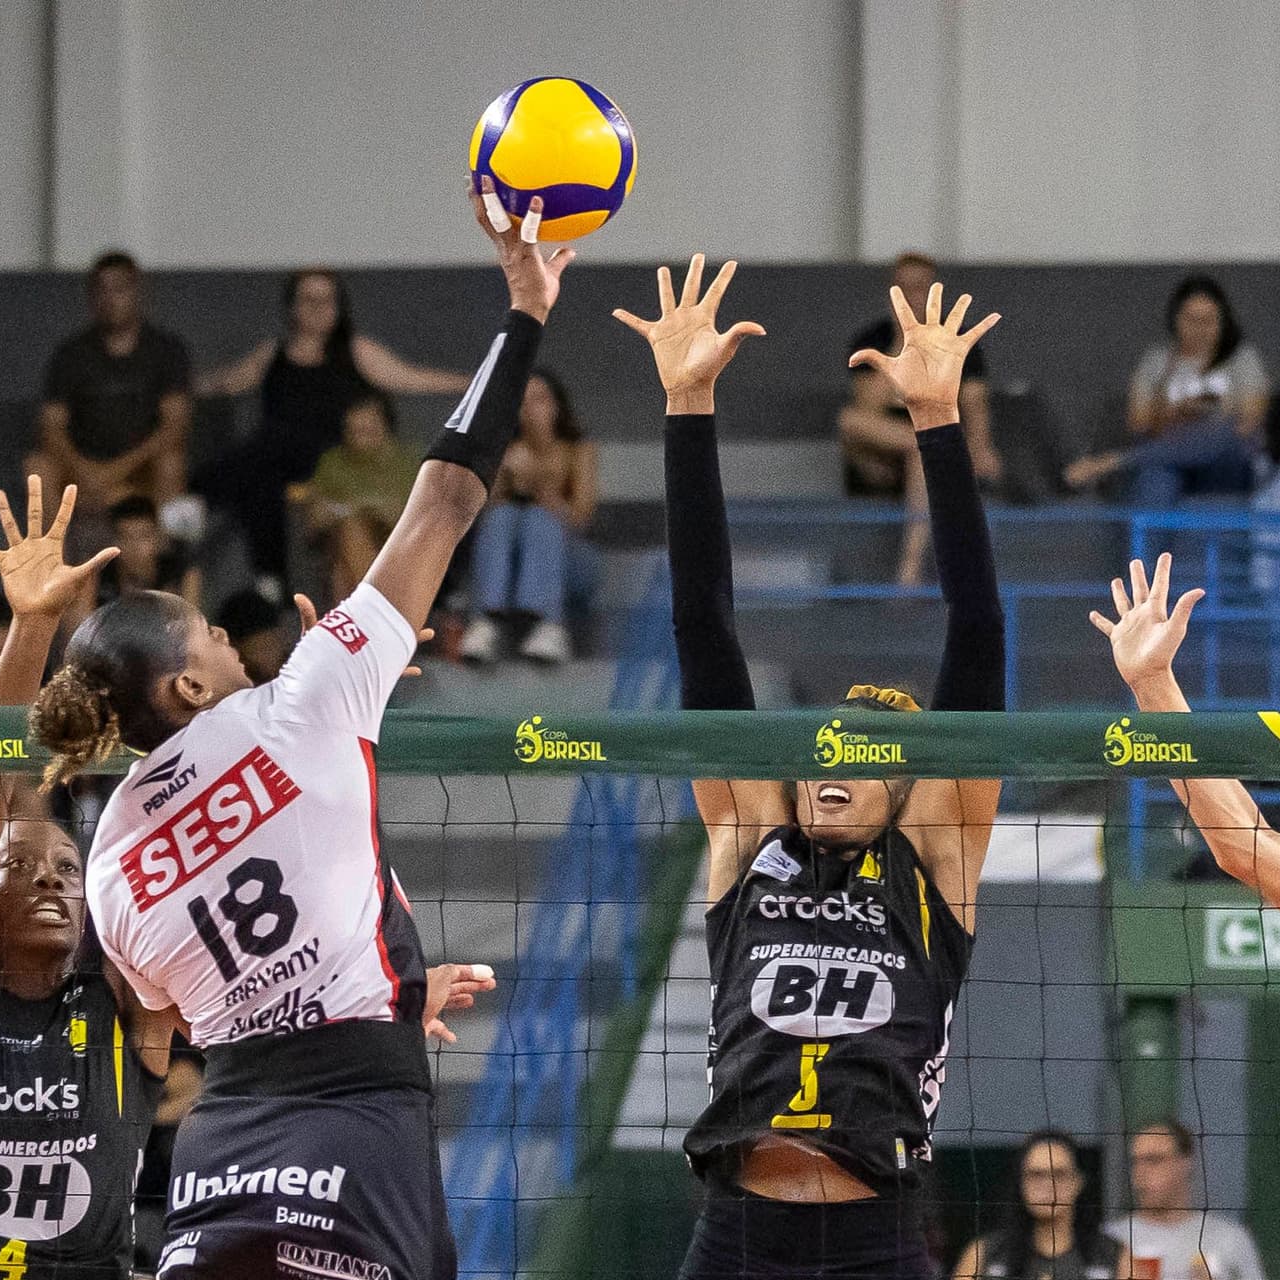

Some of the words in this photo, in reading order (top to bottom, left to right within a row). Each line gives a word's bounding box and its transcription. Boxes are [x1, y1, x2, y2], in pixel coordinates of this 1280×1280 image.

[543, 730, 568, 740] COPA
[842, 734, 869, 744] COPA
[1132, 733, 1158, 742] COPA
[544, 741, 607, 761] BRASIL
[843, 744, 907, 764] BRASIL
[1133, 742, 1198, 763] BRASIL
[142, 763, 198, 817] PENALTY
[138, 764, 275, 898] SESI
[186, 855, 300, 985] 18
[758, 891, 886, 927] crock's
[750, 943, 906, 970] SUPERMERCADOS
[768, 964, 878, 1020] BH
[172, 1164, 346, 1211] Unimed
[276, 1206, 335, 1231] Bauru
